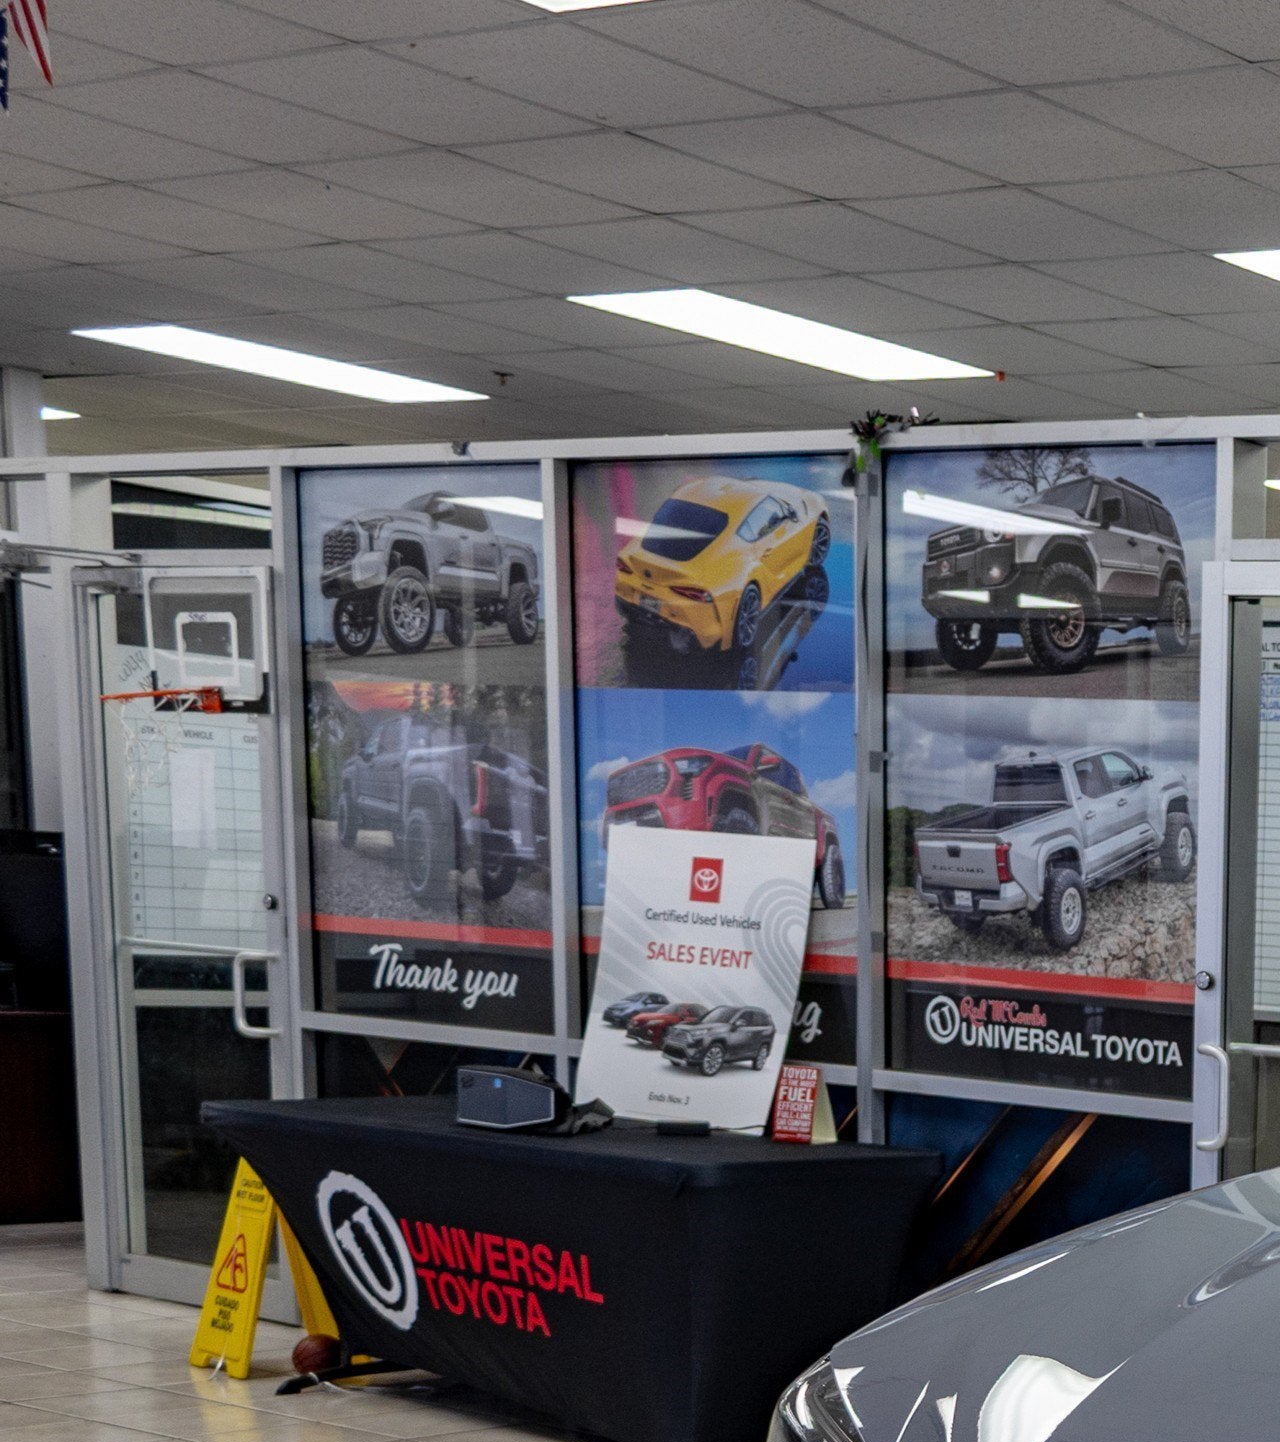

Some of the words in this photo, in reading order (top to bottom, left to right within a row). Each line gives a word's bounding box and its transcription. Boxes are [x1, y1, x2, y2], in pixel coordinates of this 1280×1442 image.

[183, 729, 213, 741] VEHICLE
[645, 907, 689, 924] Certified
[691, 912, 718, 927] Used
[719, 914, 762, 931] Vehicles
[646, 941, 696, 965] SALES
[699, 946, 753, 969] EVENT
[369, 942, 459, 994] Thank
[461, 969, 518, 1011] you
[960, 995, 987, 1028] Red
[961, 1022, 1090, 1058] UNIVERSAL
[1091, 1034, 1184, 1068] TOYOTA
[783, 1066, 818, 1080] TOYOTA
[778, 1100, 814, 1113] EFFICIENT
[779, 1085, 815, 1103] FUEL
[400, 1218, 604, 1304] UNIVERSAL
[417, 1267, 552, 1338] TOYOTA
